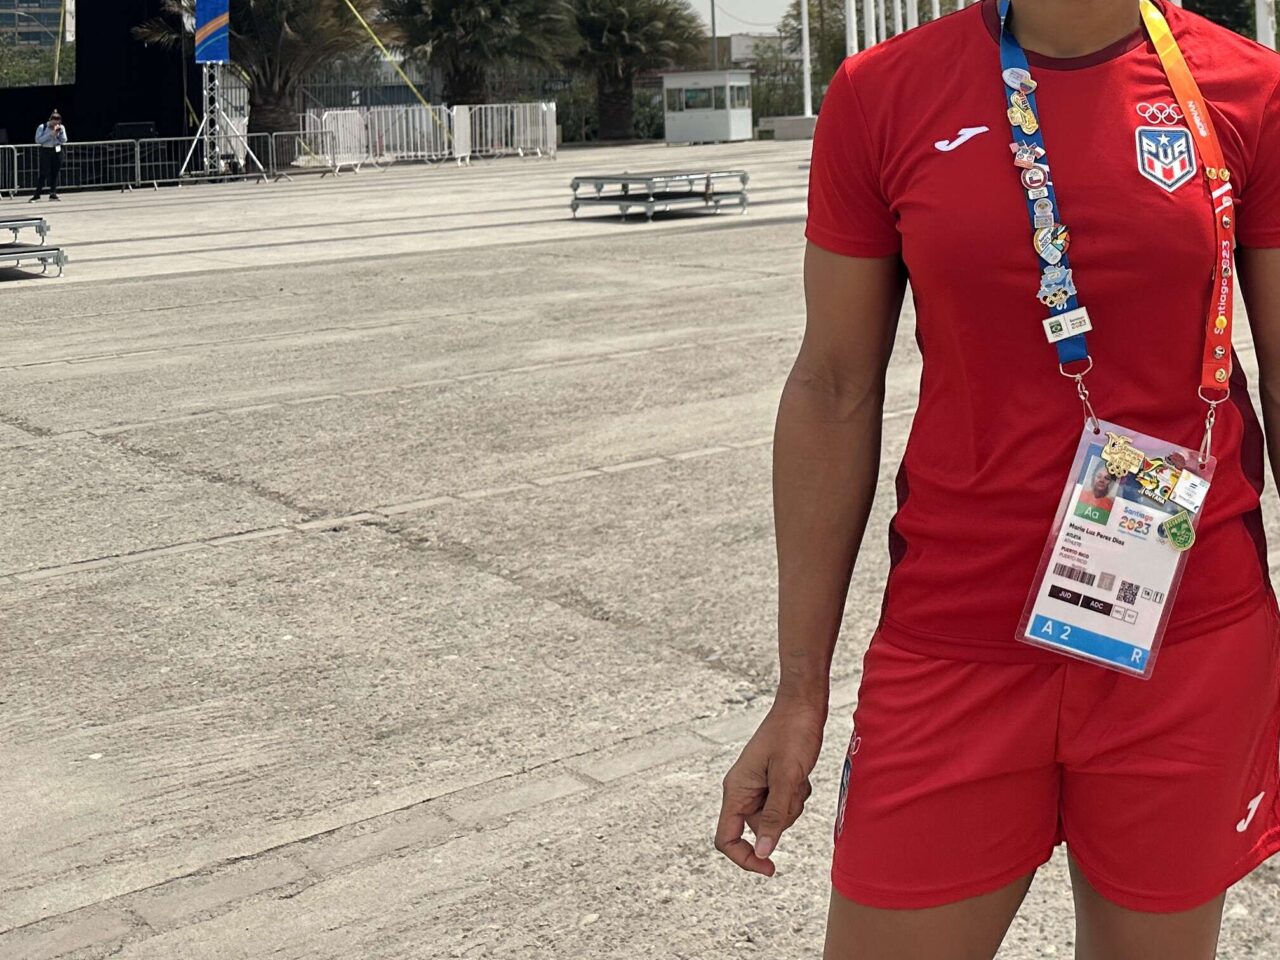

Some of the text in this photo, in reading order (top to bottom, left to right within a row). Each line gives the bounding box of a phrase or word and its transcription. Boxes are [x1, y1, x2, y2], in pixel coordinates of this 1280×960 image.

[1142, 136, 1188, 163] PUR
[1214, 240, 1231, 335] Sntiago 023
[1083, 506, 1099, 520] Aa
[1123, 506, 1153, 521] Santiago
[1118, 515, 1151, 535] 2023
[1059, 552, 1088, 565] PUERTO RICO
[1061, 546, 1089, 559] PUERTO RICO
[1059, 590, 1072, 599] JUD
[1089, 600, 1104, 610] ADC
[1041, 620, 1143, 663] A 2 R
